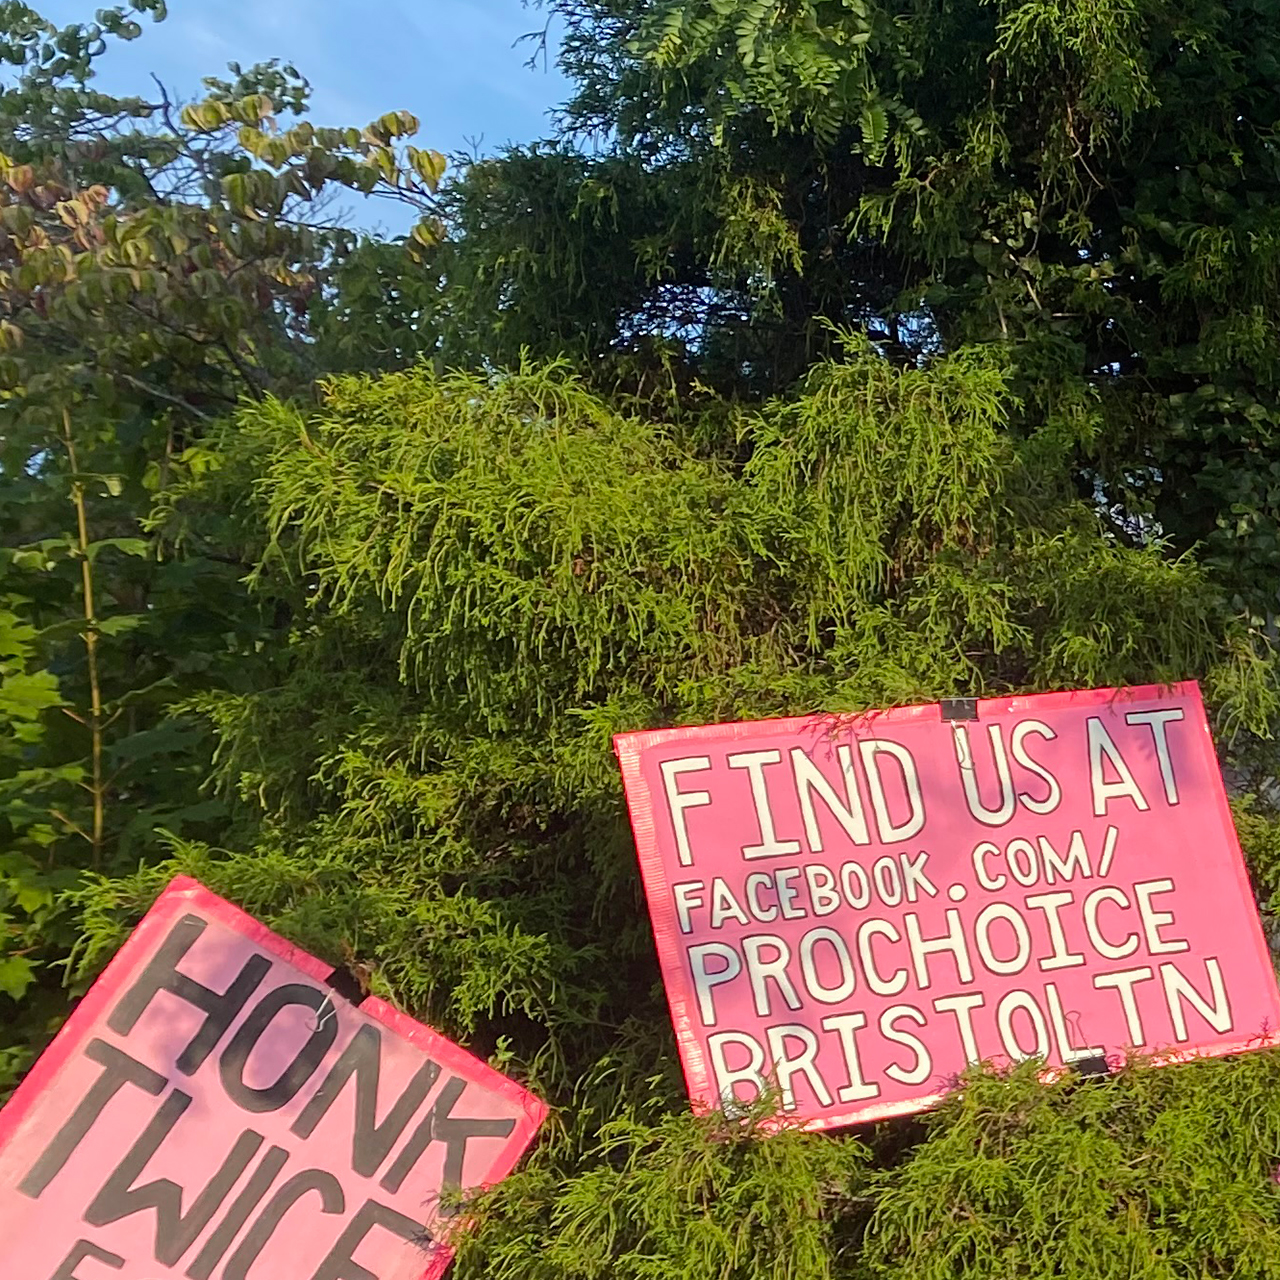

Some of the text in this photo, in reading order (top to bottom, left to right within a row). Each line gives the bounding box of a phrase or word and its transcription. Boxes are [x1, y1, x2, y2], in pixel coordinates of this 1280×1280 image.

[660, 708, 1185, 867] FIND US AT
[672, 826, 1118, 934] FACEBOOK.COM/
[687, 878, 1190, 1027] PROCHOICE
[107, 913, 515, 1216] HONK
